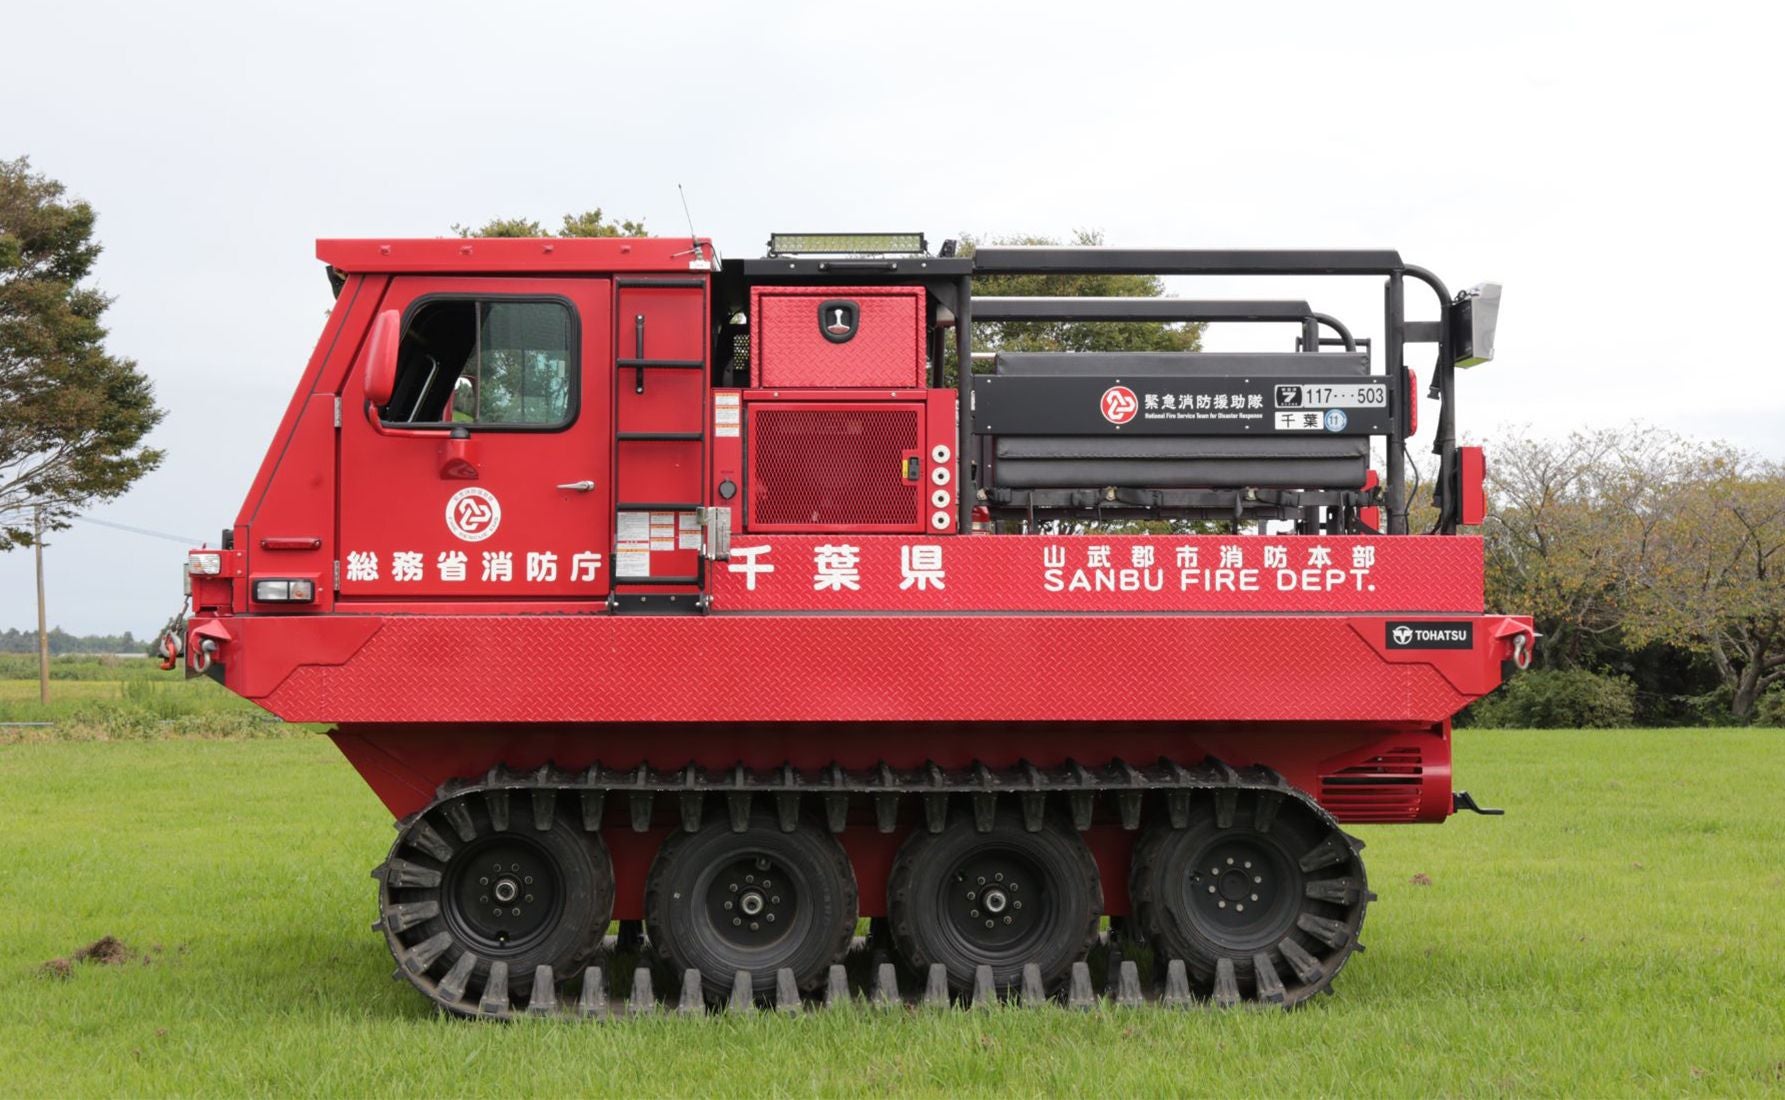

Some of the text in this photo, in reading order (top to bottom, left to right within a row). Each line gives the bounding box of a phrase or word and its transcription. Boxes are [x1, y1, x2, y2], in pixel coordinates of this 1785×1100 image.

[1144, 394, 1263, 409] 緊急消防援助隊
[1281, 413, 1318, 428] 千葉
[346, 550, 602, 582] 総務省消防庁
[728, 544, 946, 591] 千葉県
[1043, 544, 1376, 568] 山武郡市消防本部
[1043, 568, 1376, 592] SANBU FIRE DEPT.
[1414, 629, 1467, 641] TOHATSU
